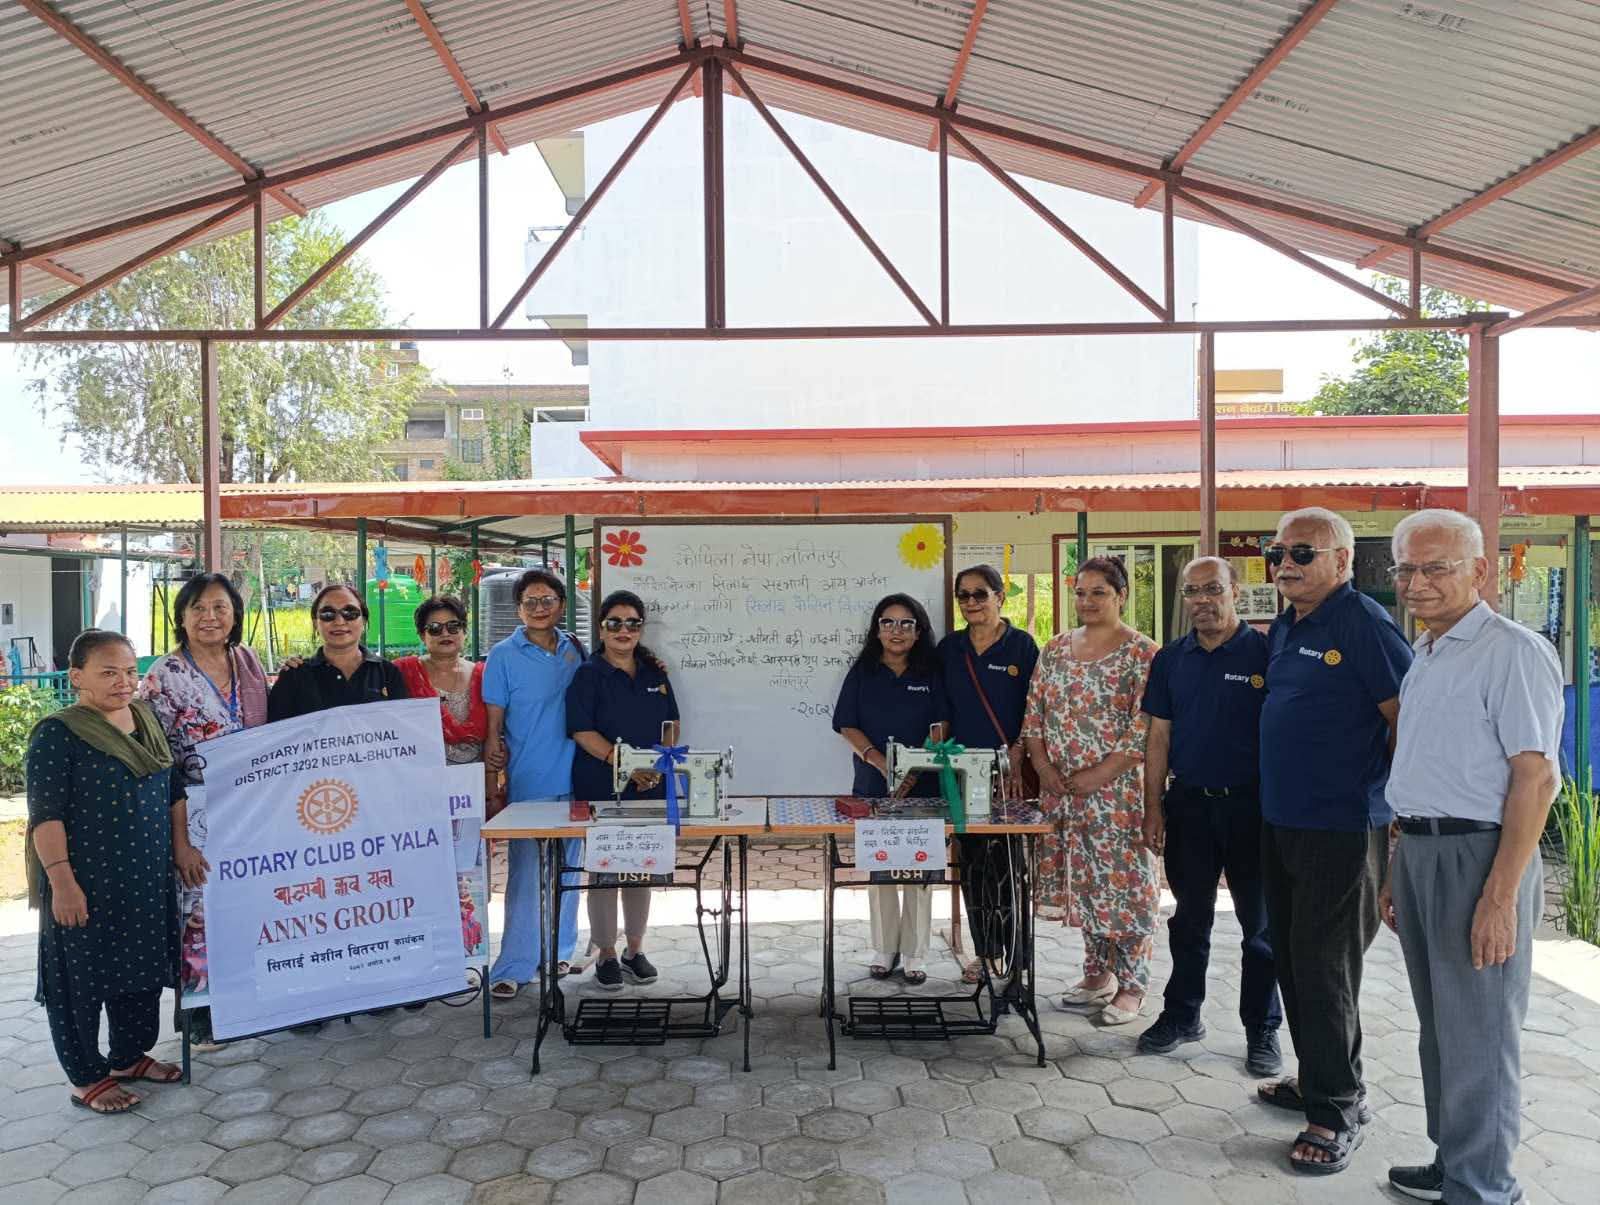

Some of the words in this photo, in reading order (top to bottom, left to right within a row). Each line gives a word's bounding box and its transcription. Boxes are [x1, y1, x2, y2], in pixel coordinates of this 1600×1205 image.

[1298, 646, 1323, 660] Rotary
[1224, 673, 1250, 683] Rotary
[235, 763, 288, 786] DISTRICT
[292, 758, 318, 773] 3292
[321, 744, 417, 769] NEPAL-BHUTAN
[251, 744, 299, 768] ROTARY
[303, 730, 399, 753] INTERNATIONAL
[448, 794, 472, 816] pa
[219, 850, 298, 881] ROTARY
[304, 841, 355, 867] CLUB
[361, 836, 385, 857] OF
[391, 828, 440, 852] YALA
[257, 912, 328, 946] ANN'S
[333, 896, 415, 932] GROUP
[267, 953, 305, 973] सिलाई
[347, 940, 389, 958] वितरण
